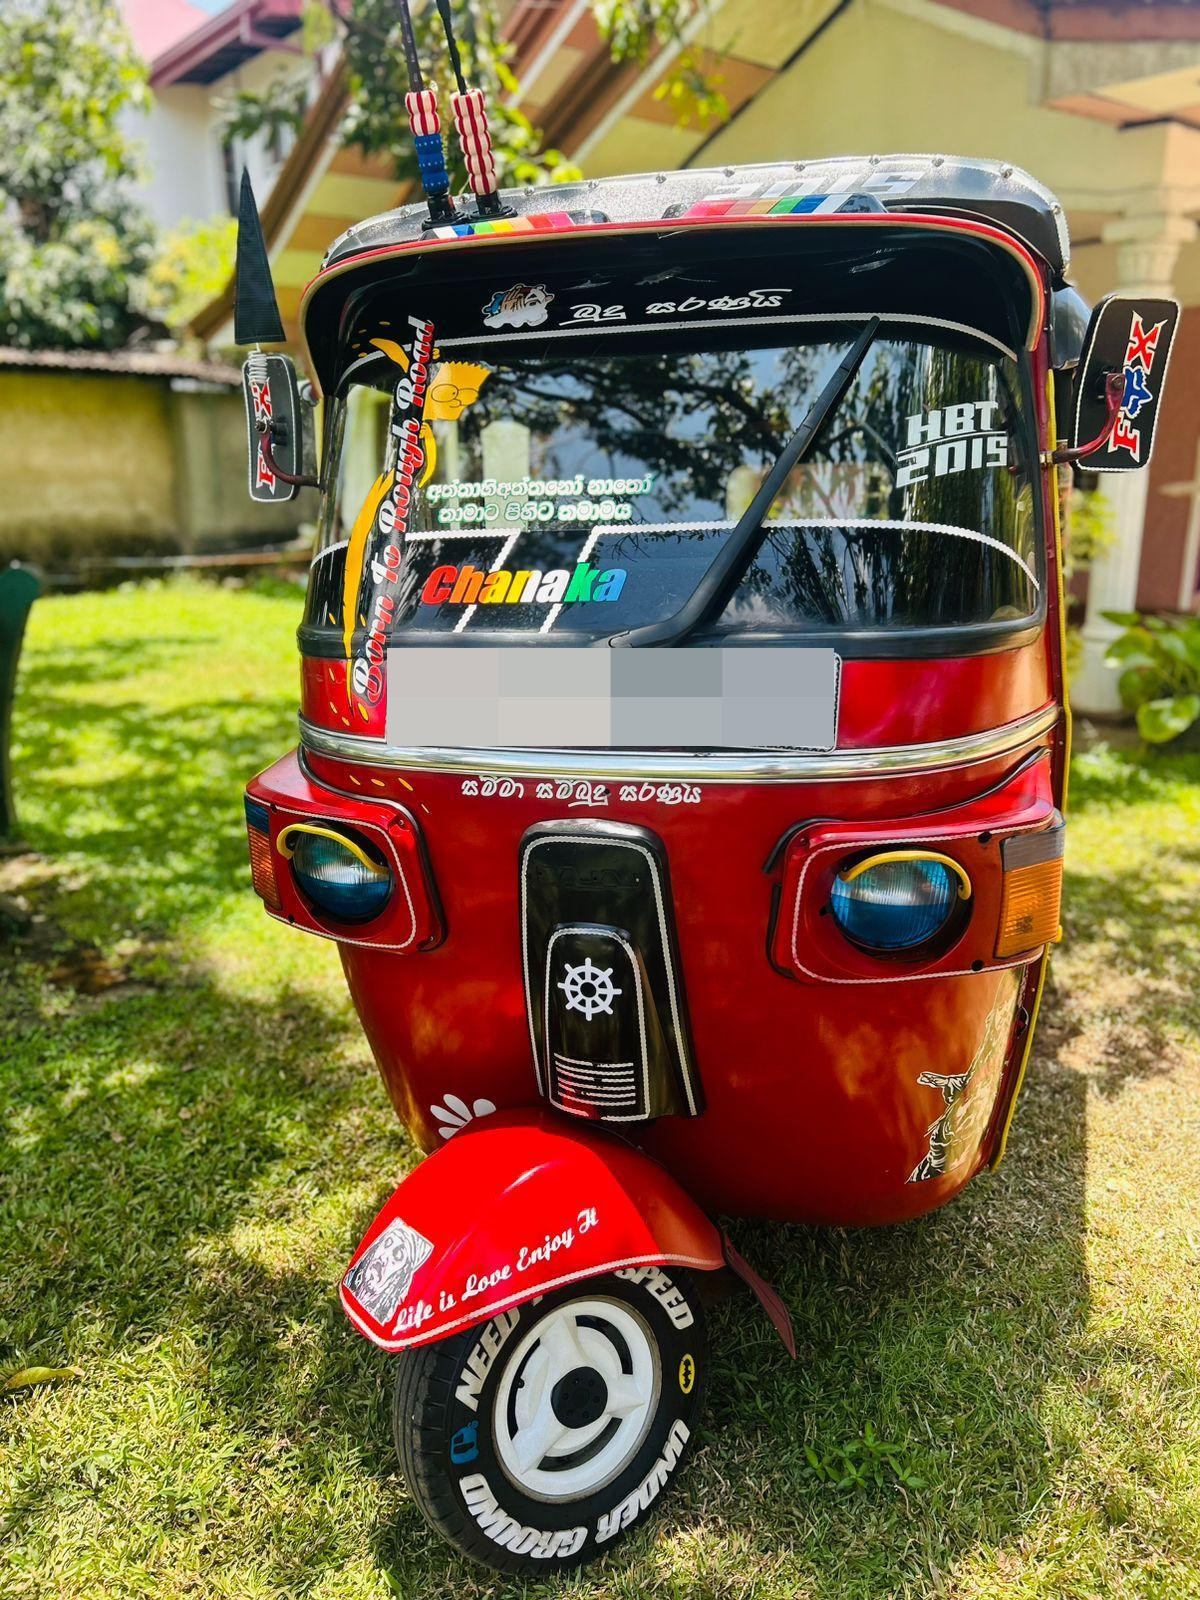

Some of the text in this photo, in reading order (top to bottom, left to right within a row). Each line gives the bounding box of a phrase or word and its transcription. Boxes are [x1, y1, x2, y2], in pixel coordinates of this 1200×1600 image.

[559, 288, 793, 326] බුදු සරණයි
[396, 315, 435, 410] Road
[250, 377, 276, 495] FX
[896, 436, 1008, 489] 2015
[905, 401, 999, 447] HBT
[378, 417, 425, 534] Rough
[421, 562, 627, 605] Chanaka
[353, 594, 394, 703] Born
[392, 1206, 599, 1336] Life is Love Enjoy It
[459, 1418, 691, 1559] UNDER GROUND
